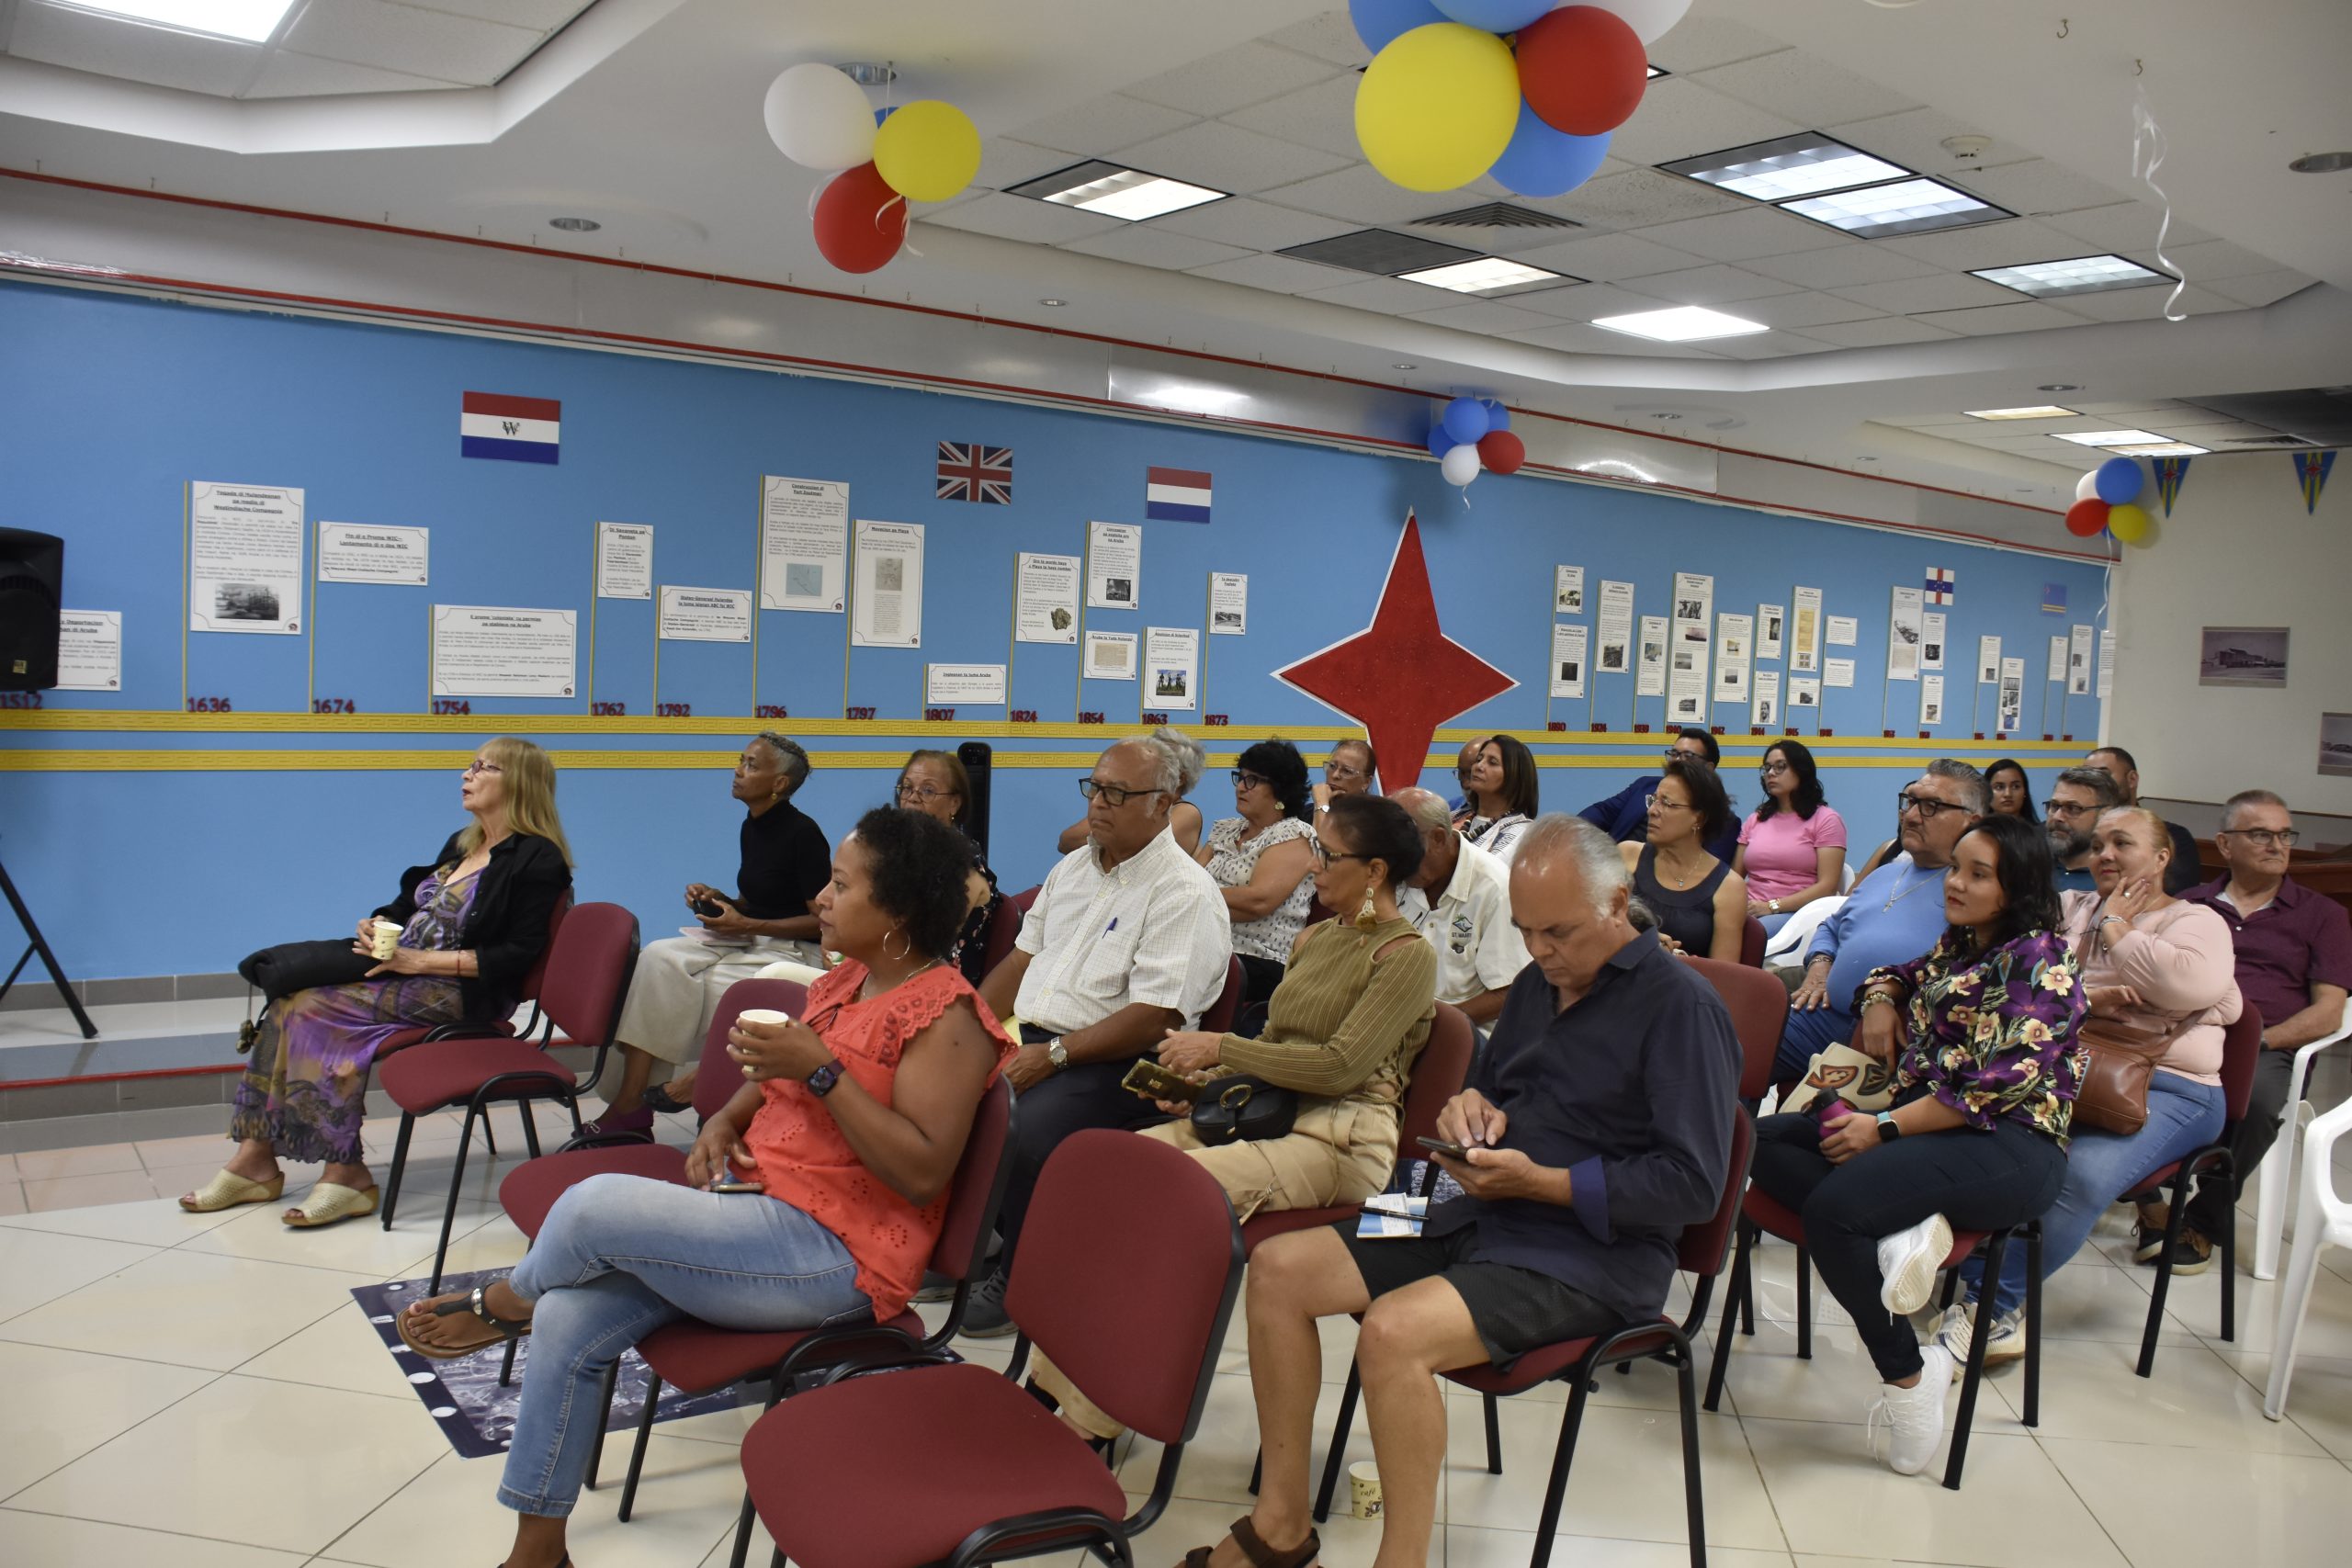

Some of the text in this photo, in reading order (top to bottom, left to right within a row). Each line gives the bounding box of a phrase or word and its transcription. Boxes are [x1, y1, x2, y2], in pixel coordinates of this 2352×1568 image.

[503, 421, 520, 435] W
[187, 697, 232, 713] 1636
[312, 699, 356, 714] 1674
[433, 701, 470, 716] 1754
[592, 702, 626, 716] 1762
[657, 703, 691, 717] 1792
[846, 706, 876, 720] 1797
[924, 708, 956, 721] 1807
[1011, 710, 1037, 723] 1824
[1078, 712, 1105, 724] 1854
[1141, 714, 1169, 726] 1863
[1204, 715, 1229, 727] 1873
